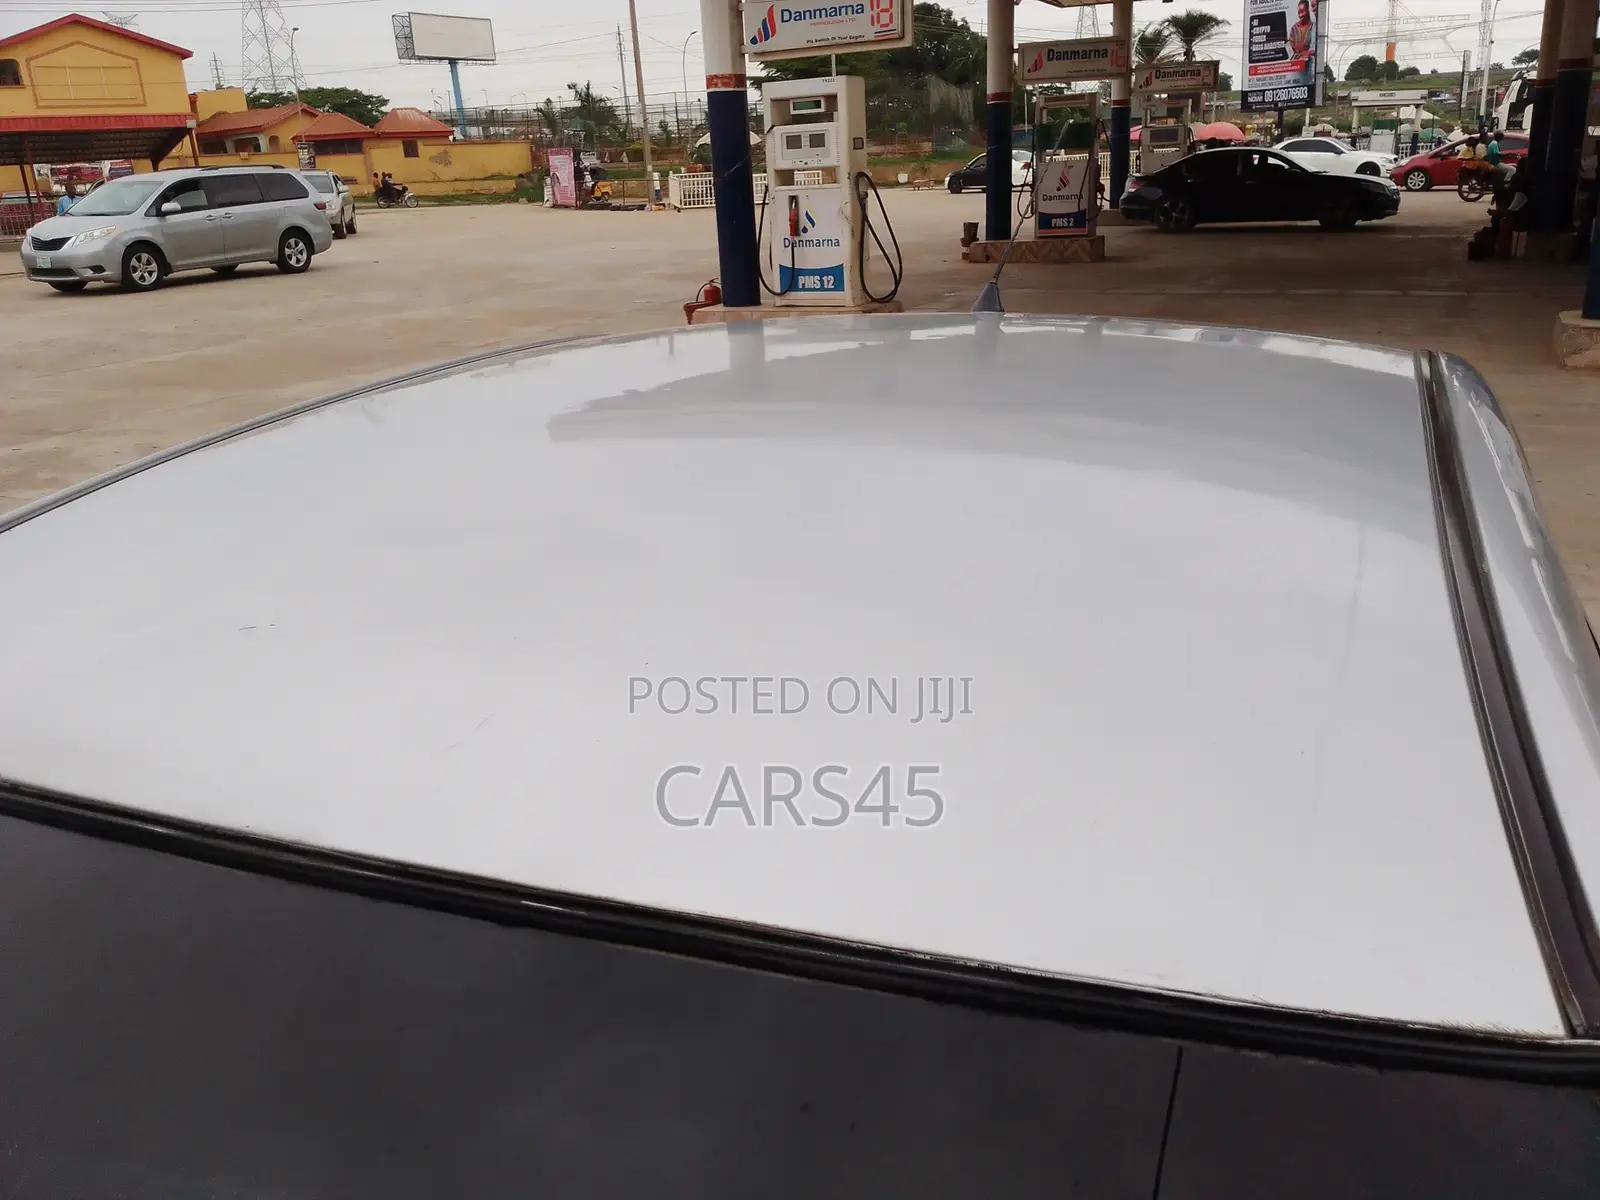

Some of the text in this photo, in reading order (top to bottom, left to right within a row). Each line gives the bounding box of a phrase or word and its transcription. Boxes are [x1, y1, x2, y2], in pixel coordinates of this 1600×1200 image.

[781, 3, 864, 23] Danmarna
[1047, 48, 1108, 61] Danmarna
[1155, 68, 1201, 79] Danmarna
[1264, 86, 1308, 102] 09126076503
[1051, 217, 1075, 227] PMS 2
[783, 237, 840, 248] Danmarna
[798, 275, 835, 289] PMS 12
